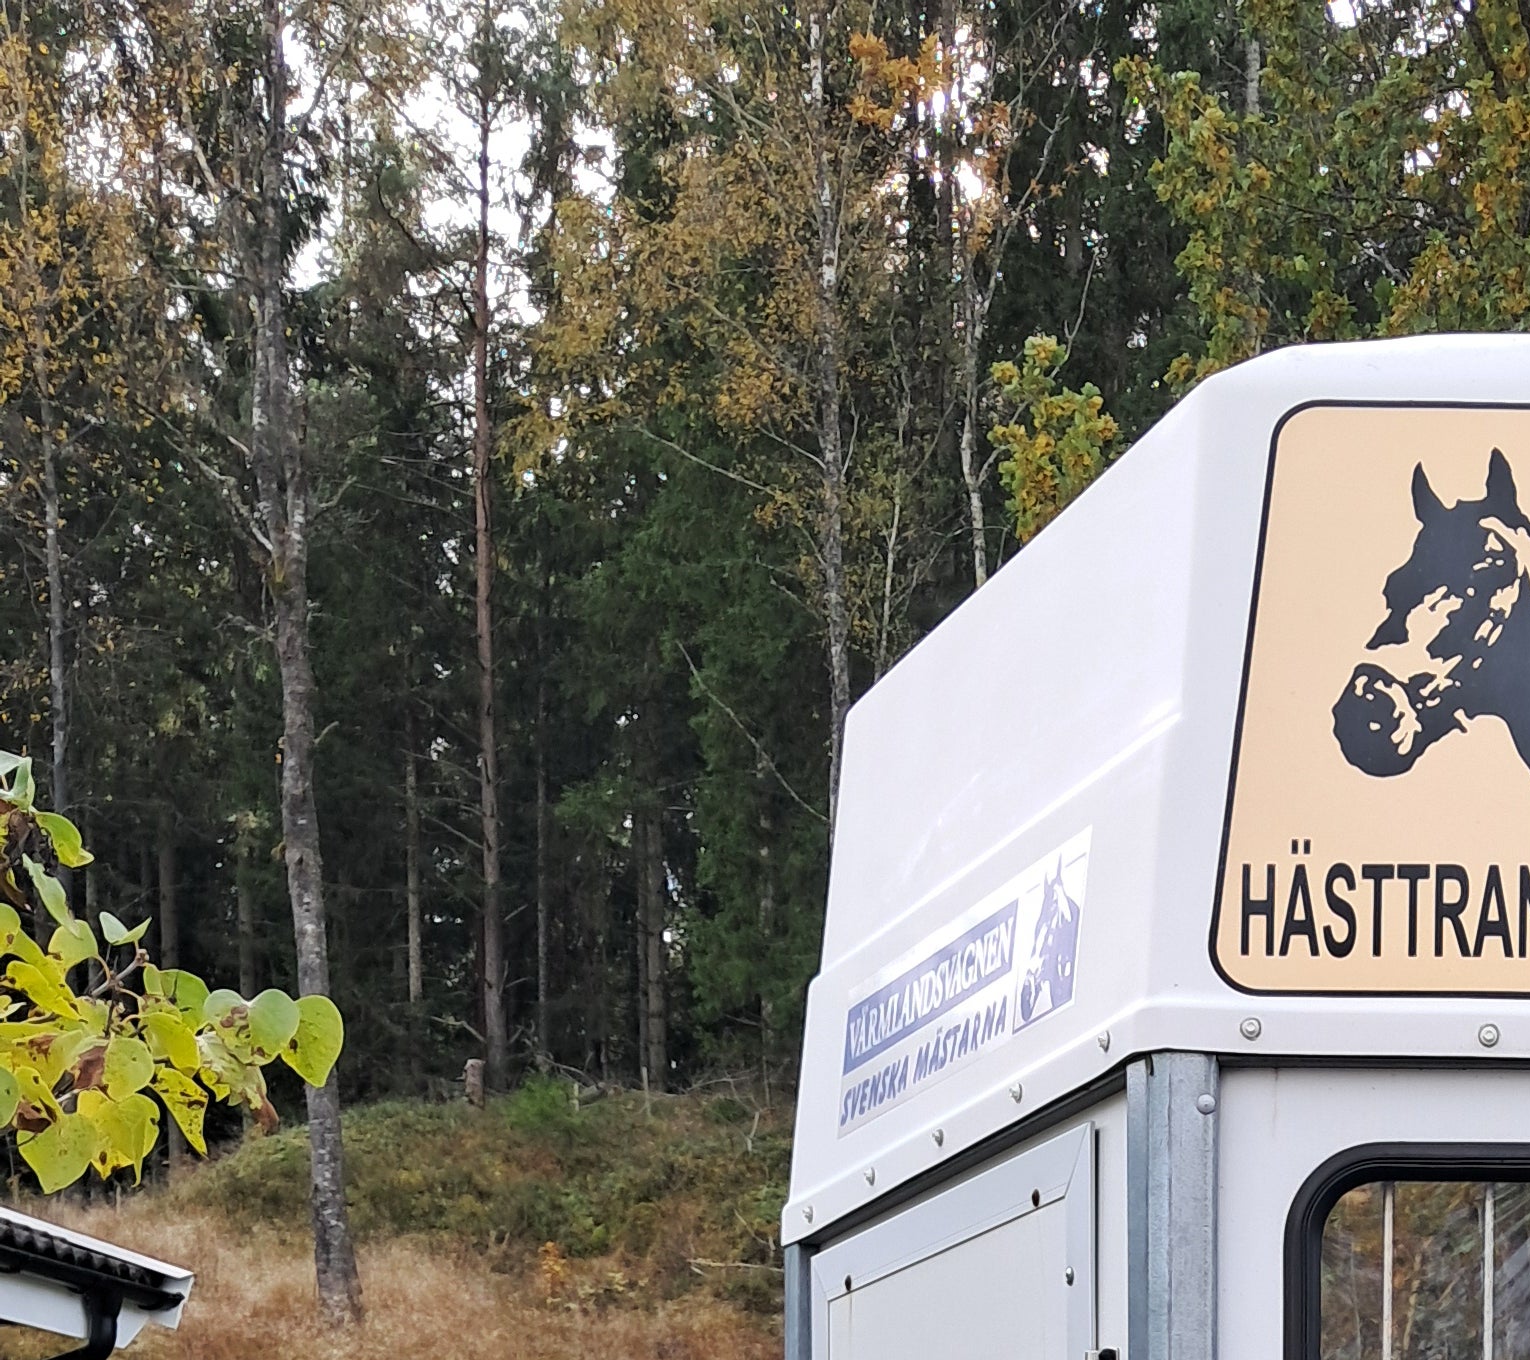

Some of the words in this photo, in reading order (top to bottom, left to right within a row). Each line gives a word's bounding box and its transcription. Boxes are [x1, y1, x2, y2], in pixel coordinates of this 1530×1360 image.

[848, 917, 1014, 1058] VÄRMLANDSVAGNEN
[840, 1054, 909, 1127] SVENSKA
[912, 995, 1008, 1084] MÄSTARNA
